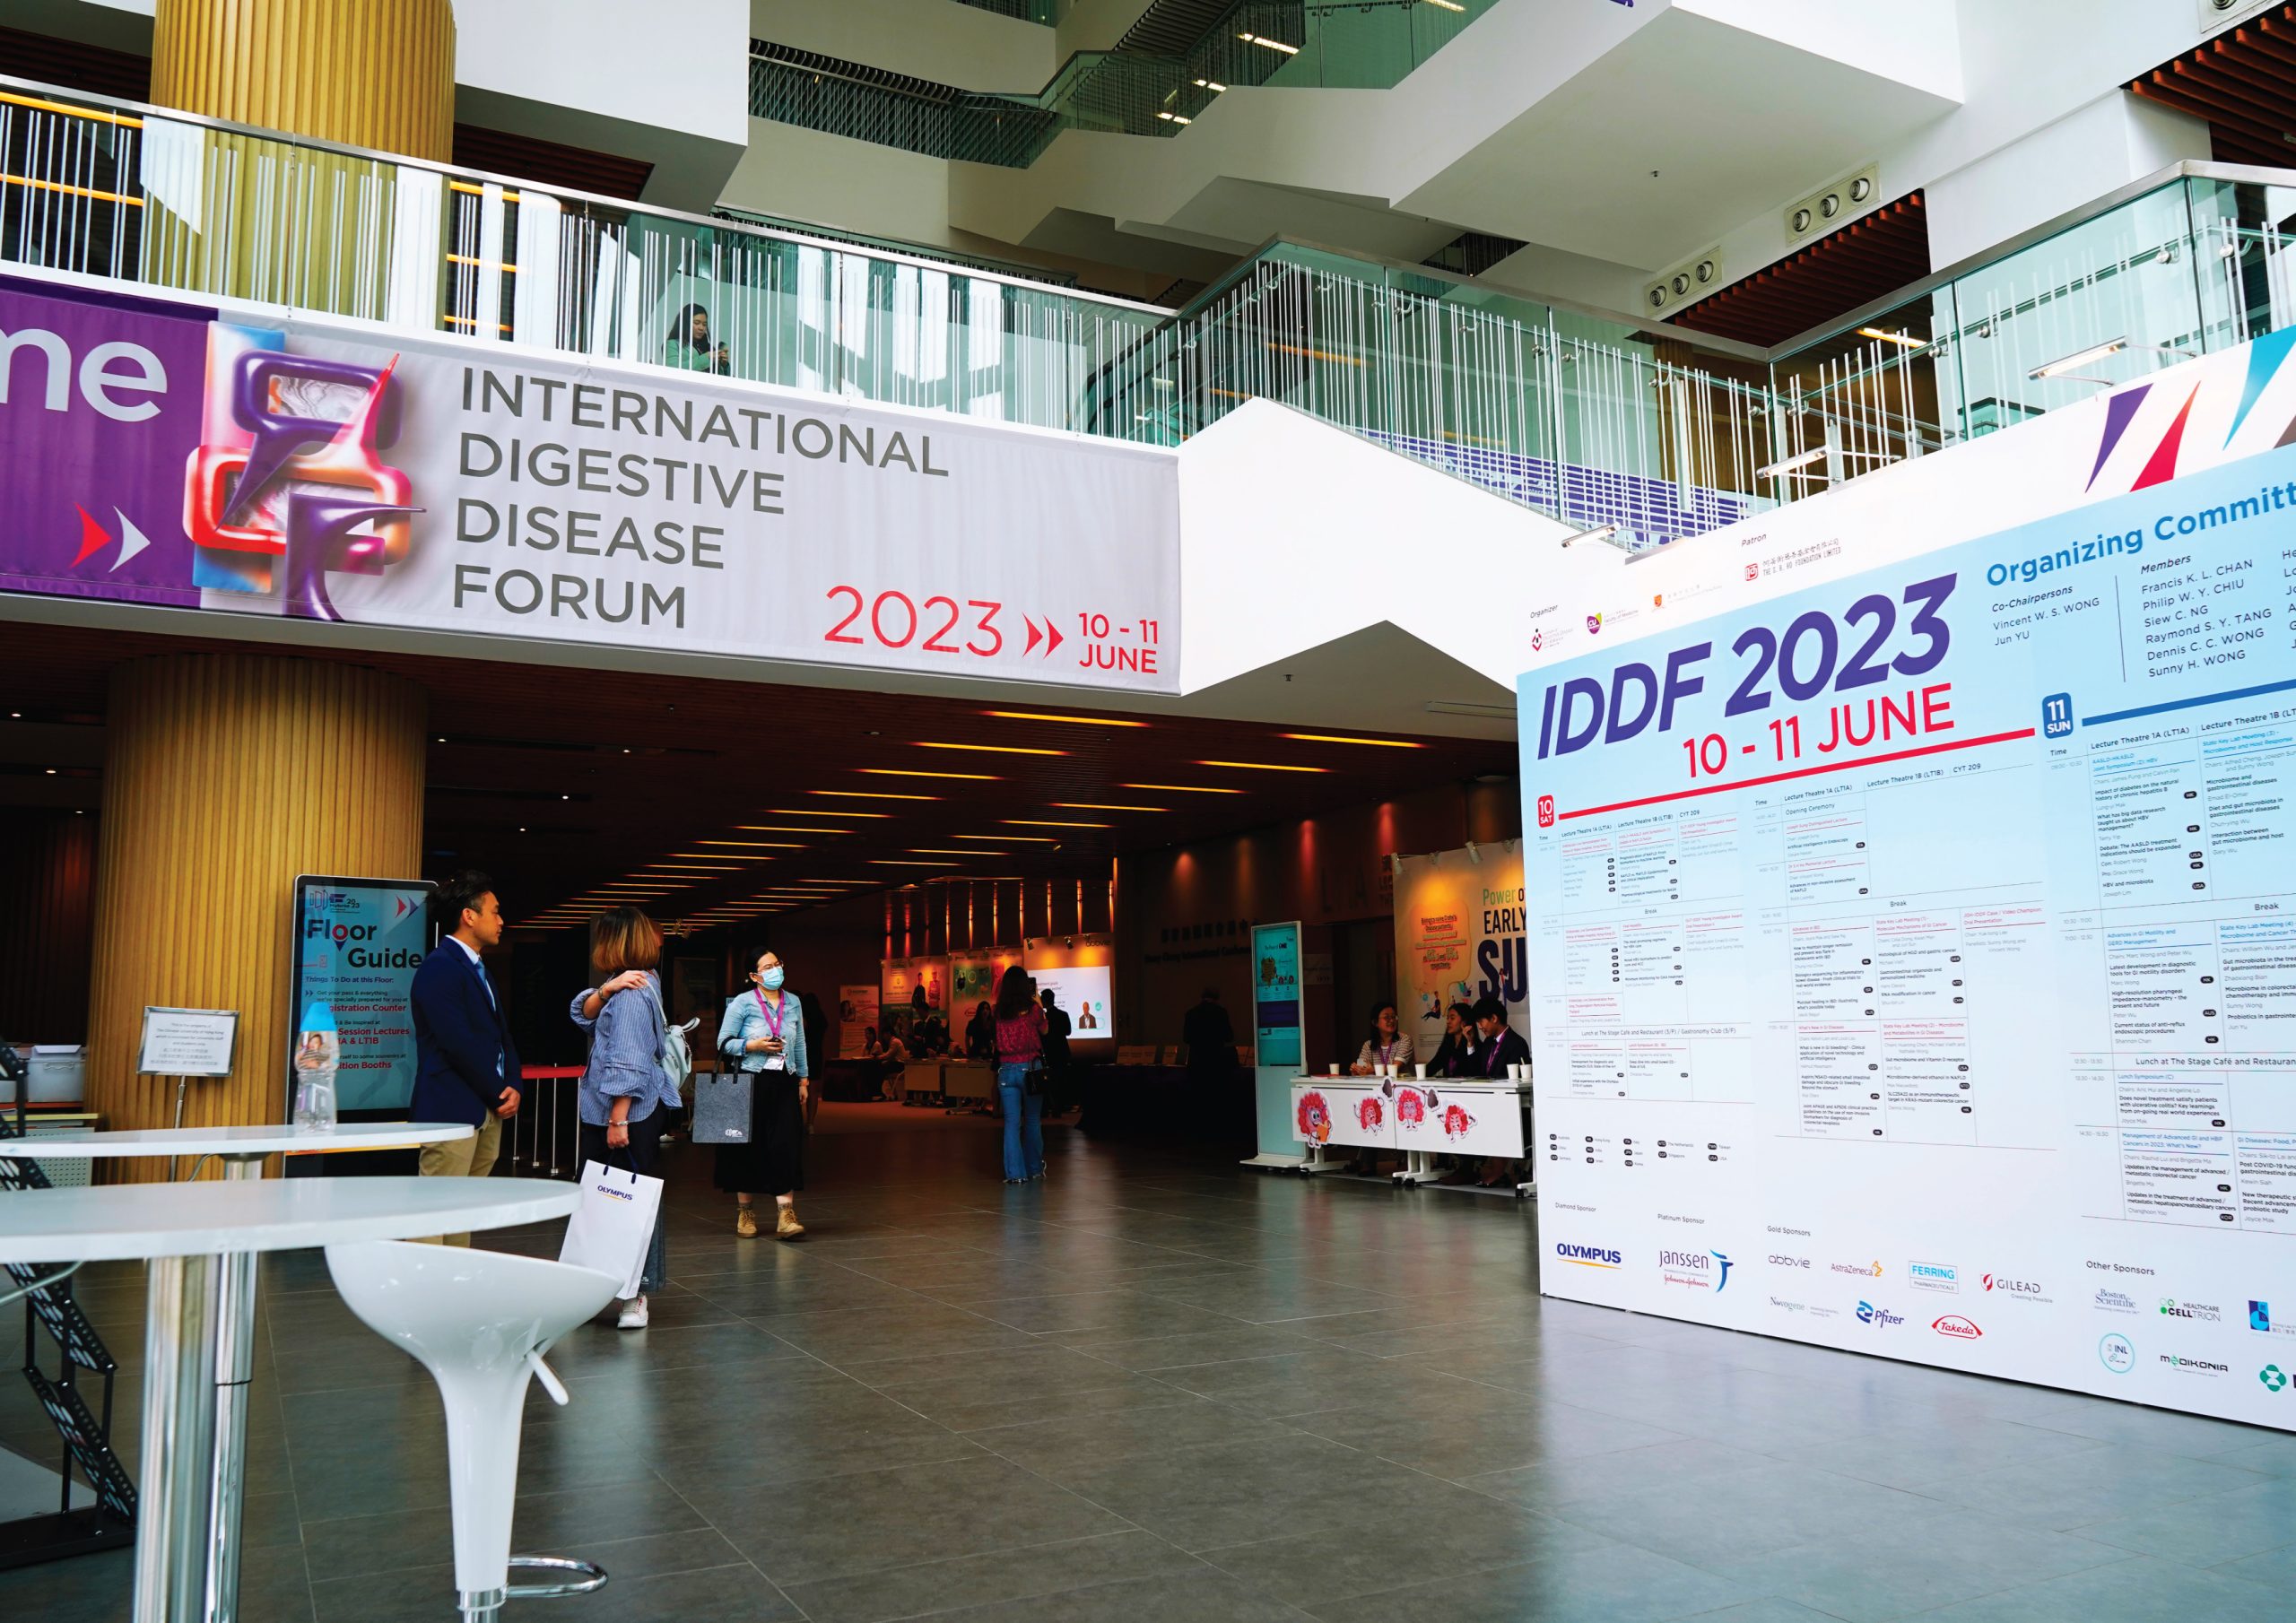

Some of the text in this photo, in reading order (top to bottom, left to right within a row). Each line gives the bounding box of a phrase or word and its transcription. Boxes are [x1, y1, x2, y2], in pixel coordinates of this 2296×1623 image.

[462, 366, 949, 477] INTERNATIONAL
[459, 432, 785, 515] DIGESTIVE
[456, 498, 725, 569] DISEASE
[1742, 534, 1766, 547] Patron
[1987, 482, 2296, 586] Organizing Committ
[1796, 552, 1821, 567] FOUNDATION
[2141, 555, 2191, 574] Members
[2142, 560, 2253, 595] Francis K. L. CHAN
[454, 566, 686, 629] FORUM
[1992, 586, 2073, 612] Co-Chairpersons
[2144, 579, 2244, 611] Philip W. Y. CHIU
[1530, 604, 1558, 619] Organizer
[1993, 598, 2100, 629] Vincent W. S. WONG
[2144, 605, 2209, 628] Siew C. NG
[824, 585, 1003, 657] 2023
[1079, 612, 1158, 645] 10 11
[2146, 608, 2272, 644] Raymond S. Y. TANG
[1995, 630, 2030, 646] Jun YU
[2147, 628, 2265, 661] Dennis C. C. WONG
[1079, 643, 1158, 674] JUNE
[1537, 572, 1957, 759] IDDF 2023
[2149, 650, 2246, 677] Sunny H. WONG
[2048, 699, 2066, 721] 11
[1683, 682, 1955, 778] 10 11 JUNE
[2047, 721, 2071, 733] SUN
[2201, 720, 2232, 731] Lecture
[2235, 715, 2267, 725] Theatre
[2092, 739, 2118, 750] Lecture
[2121, 734, 2150, 744] Theatre
[2163, 727, 2189, 737] (LT1A)
[2050, 749, 2066, 757] Time
[1953, 763, 1981, 774] CYT 209
[1867, 778, 1890, 788] Lecture
[1891, 775, 1914, 784] Theatre
[1924, 769, 1944, 779] (LT1B)
[2206, 777, 2239, 785] Microbiome
[2207, 781, 2251, 792] gastrointestinal
[1784, 792, 1804, 802] Lecture
[1805, 789, 1825, 798] Theatre
[1834, 784, 1853, 794] (LT1A)
[1539, 800, 1552, 814] 10
[1785, 803, 1835, 816] Opening Ceremony
[1540, 814, 1552, 824] SAT
[2222, 836, 2257, 844] microbiome
[1483, 888, 1525, 906] Power o
[1890, 899, 1907, 907] Break
[1484, 907, 1526, 934] EARLY
[307, 919, 377, 941] Floor
[348, 947, 422, 968] Guide
[330, 1004, 370, 1012] gistration
[2170, 1057, 2186, 1065] The
[2187, 1058, 2211, 1067] Stage
[2213, 1056, 2231, 1065] Café
[2253, 1057, 2296, 1065] Restauran
[597, 1185, 633, 1201] OLYMPUS
[1555, 1202, 1596, 1212] Diamond Sponsor
[1657, 1213, 1705, 1226] Platinum Sponsor
[1767, 1225, 1811, 1237] Gold Sponsors
[1556, 1243, 1622, 1264] OLYMPUS
[1659, 1250, 1709, 1269] janssen
[1769, 1254, 1811, 1269] abbvie
[1831, 1263, 1874, 1277] AstraZeneca
[1912, 1265, 1955, 1280] FERRING
[2086, 1261, 2155, 1276] Other Sponsors
[1996, 1278, 2040, 1294] GILEAD
[2100, 1289, 2126, 1299] Boston
[1770, 1297, 1805, 1312] Novogene
[2095, 1293, 2136, 1308] Scientific
[2183, 1302, 2220, 1312] HEALTHCARE
[1874, 1309, 1904, 1328] Pfizer
[2168, 1307, 2221, 1322] CELLTRION
[1941, 1322, 1974, 1335] Takeda
[2114, 1344, 2127, 1354] INL
